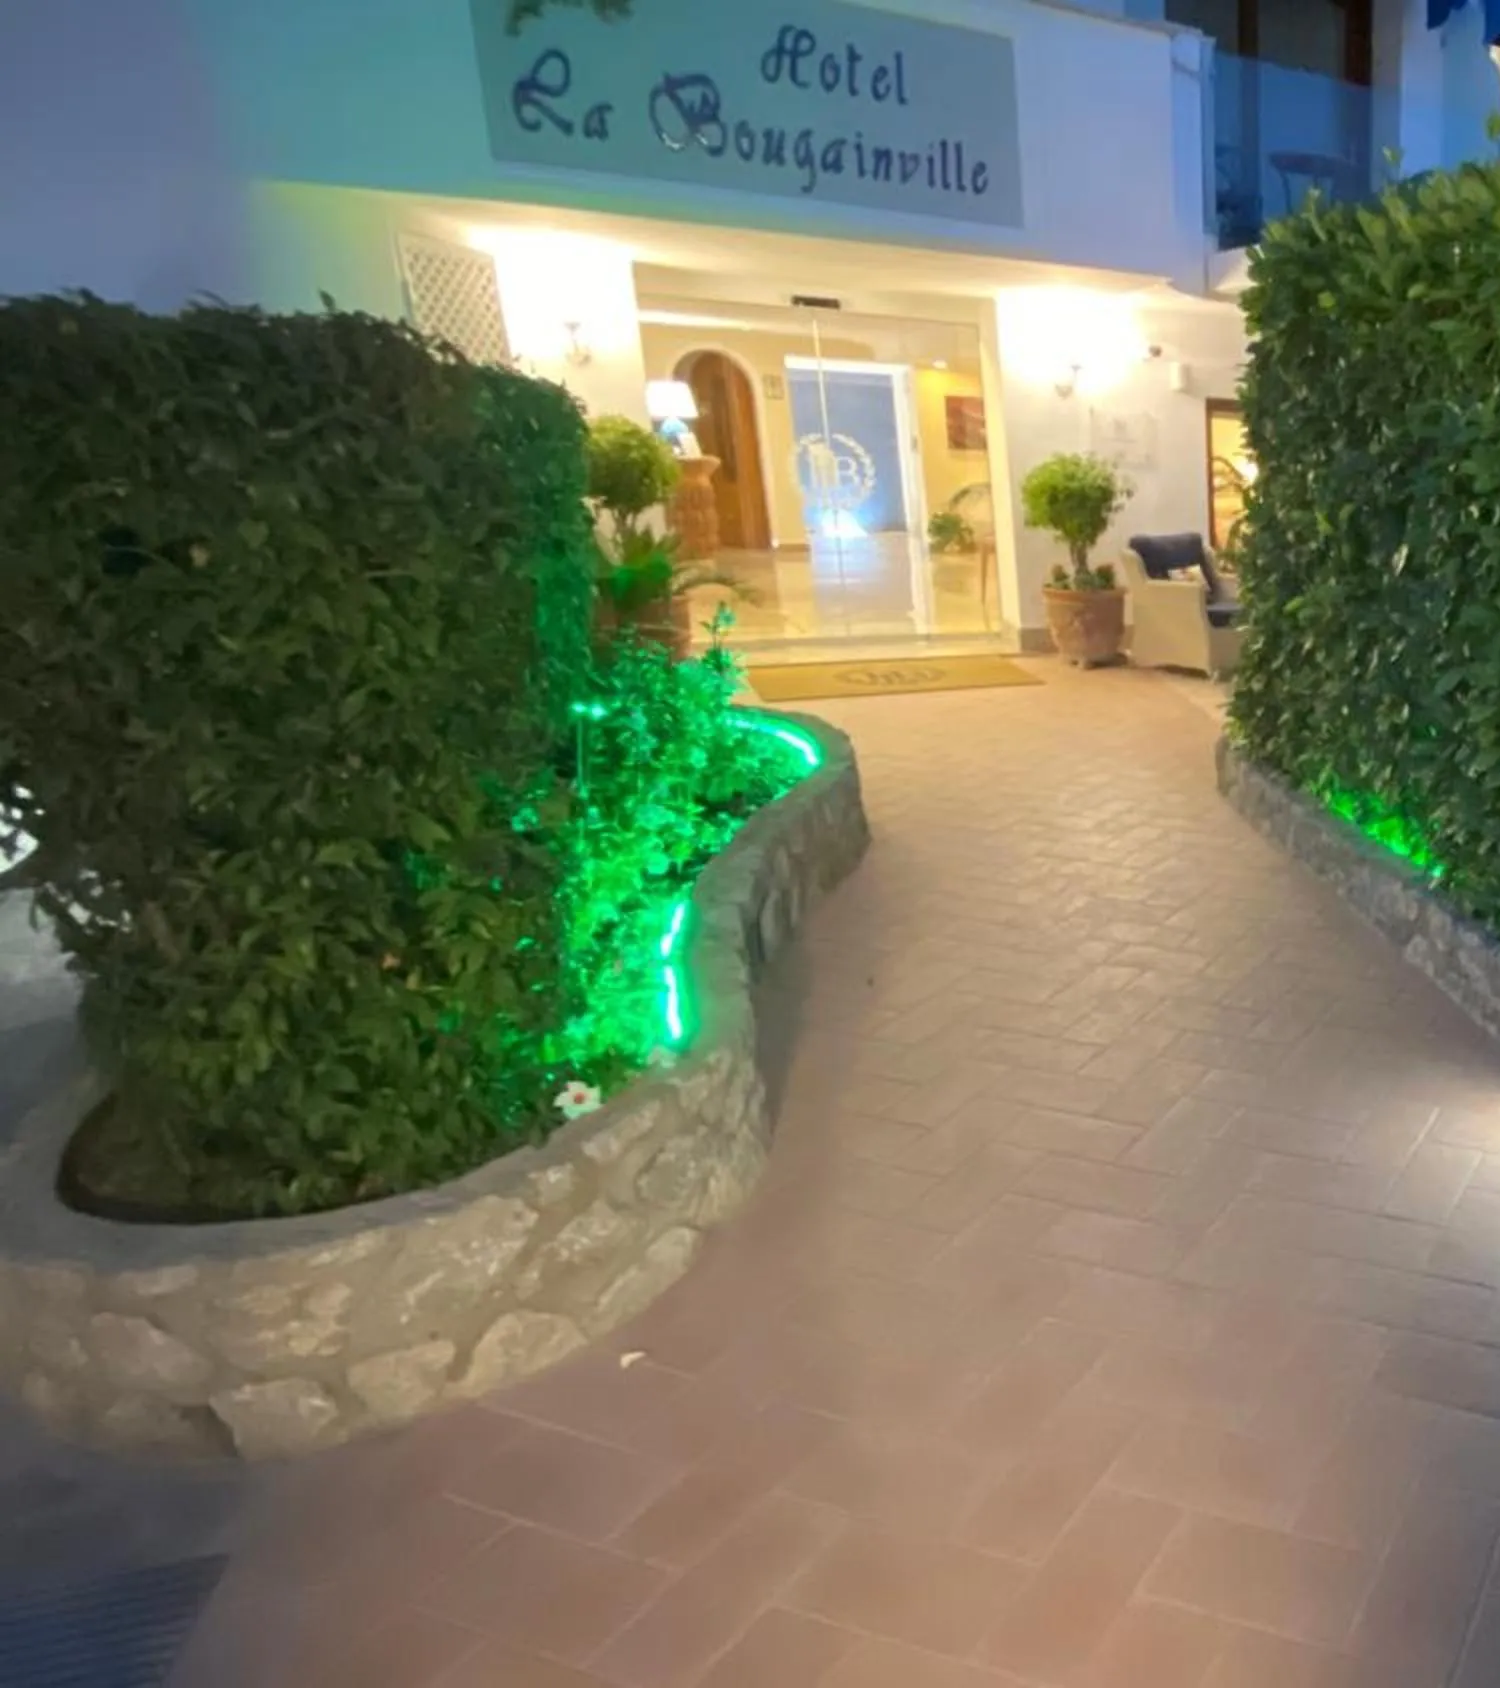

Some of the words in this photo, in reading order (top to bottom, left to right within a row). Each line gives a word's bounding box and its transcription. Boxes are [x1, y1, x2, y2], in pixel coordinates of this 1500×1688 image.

[760, 24, 908, 105] Hotel
[512, 49, 613, 141] La
[649, 73, 989, 195] Bougainville
